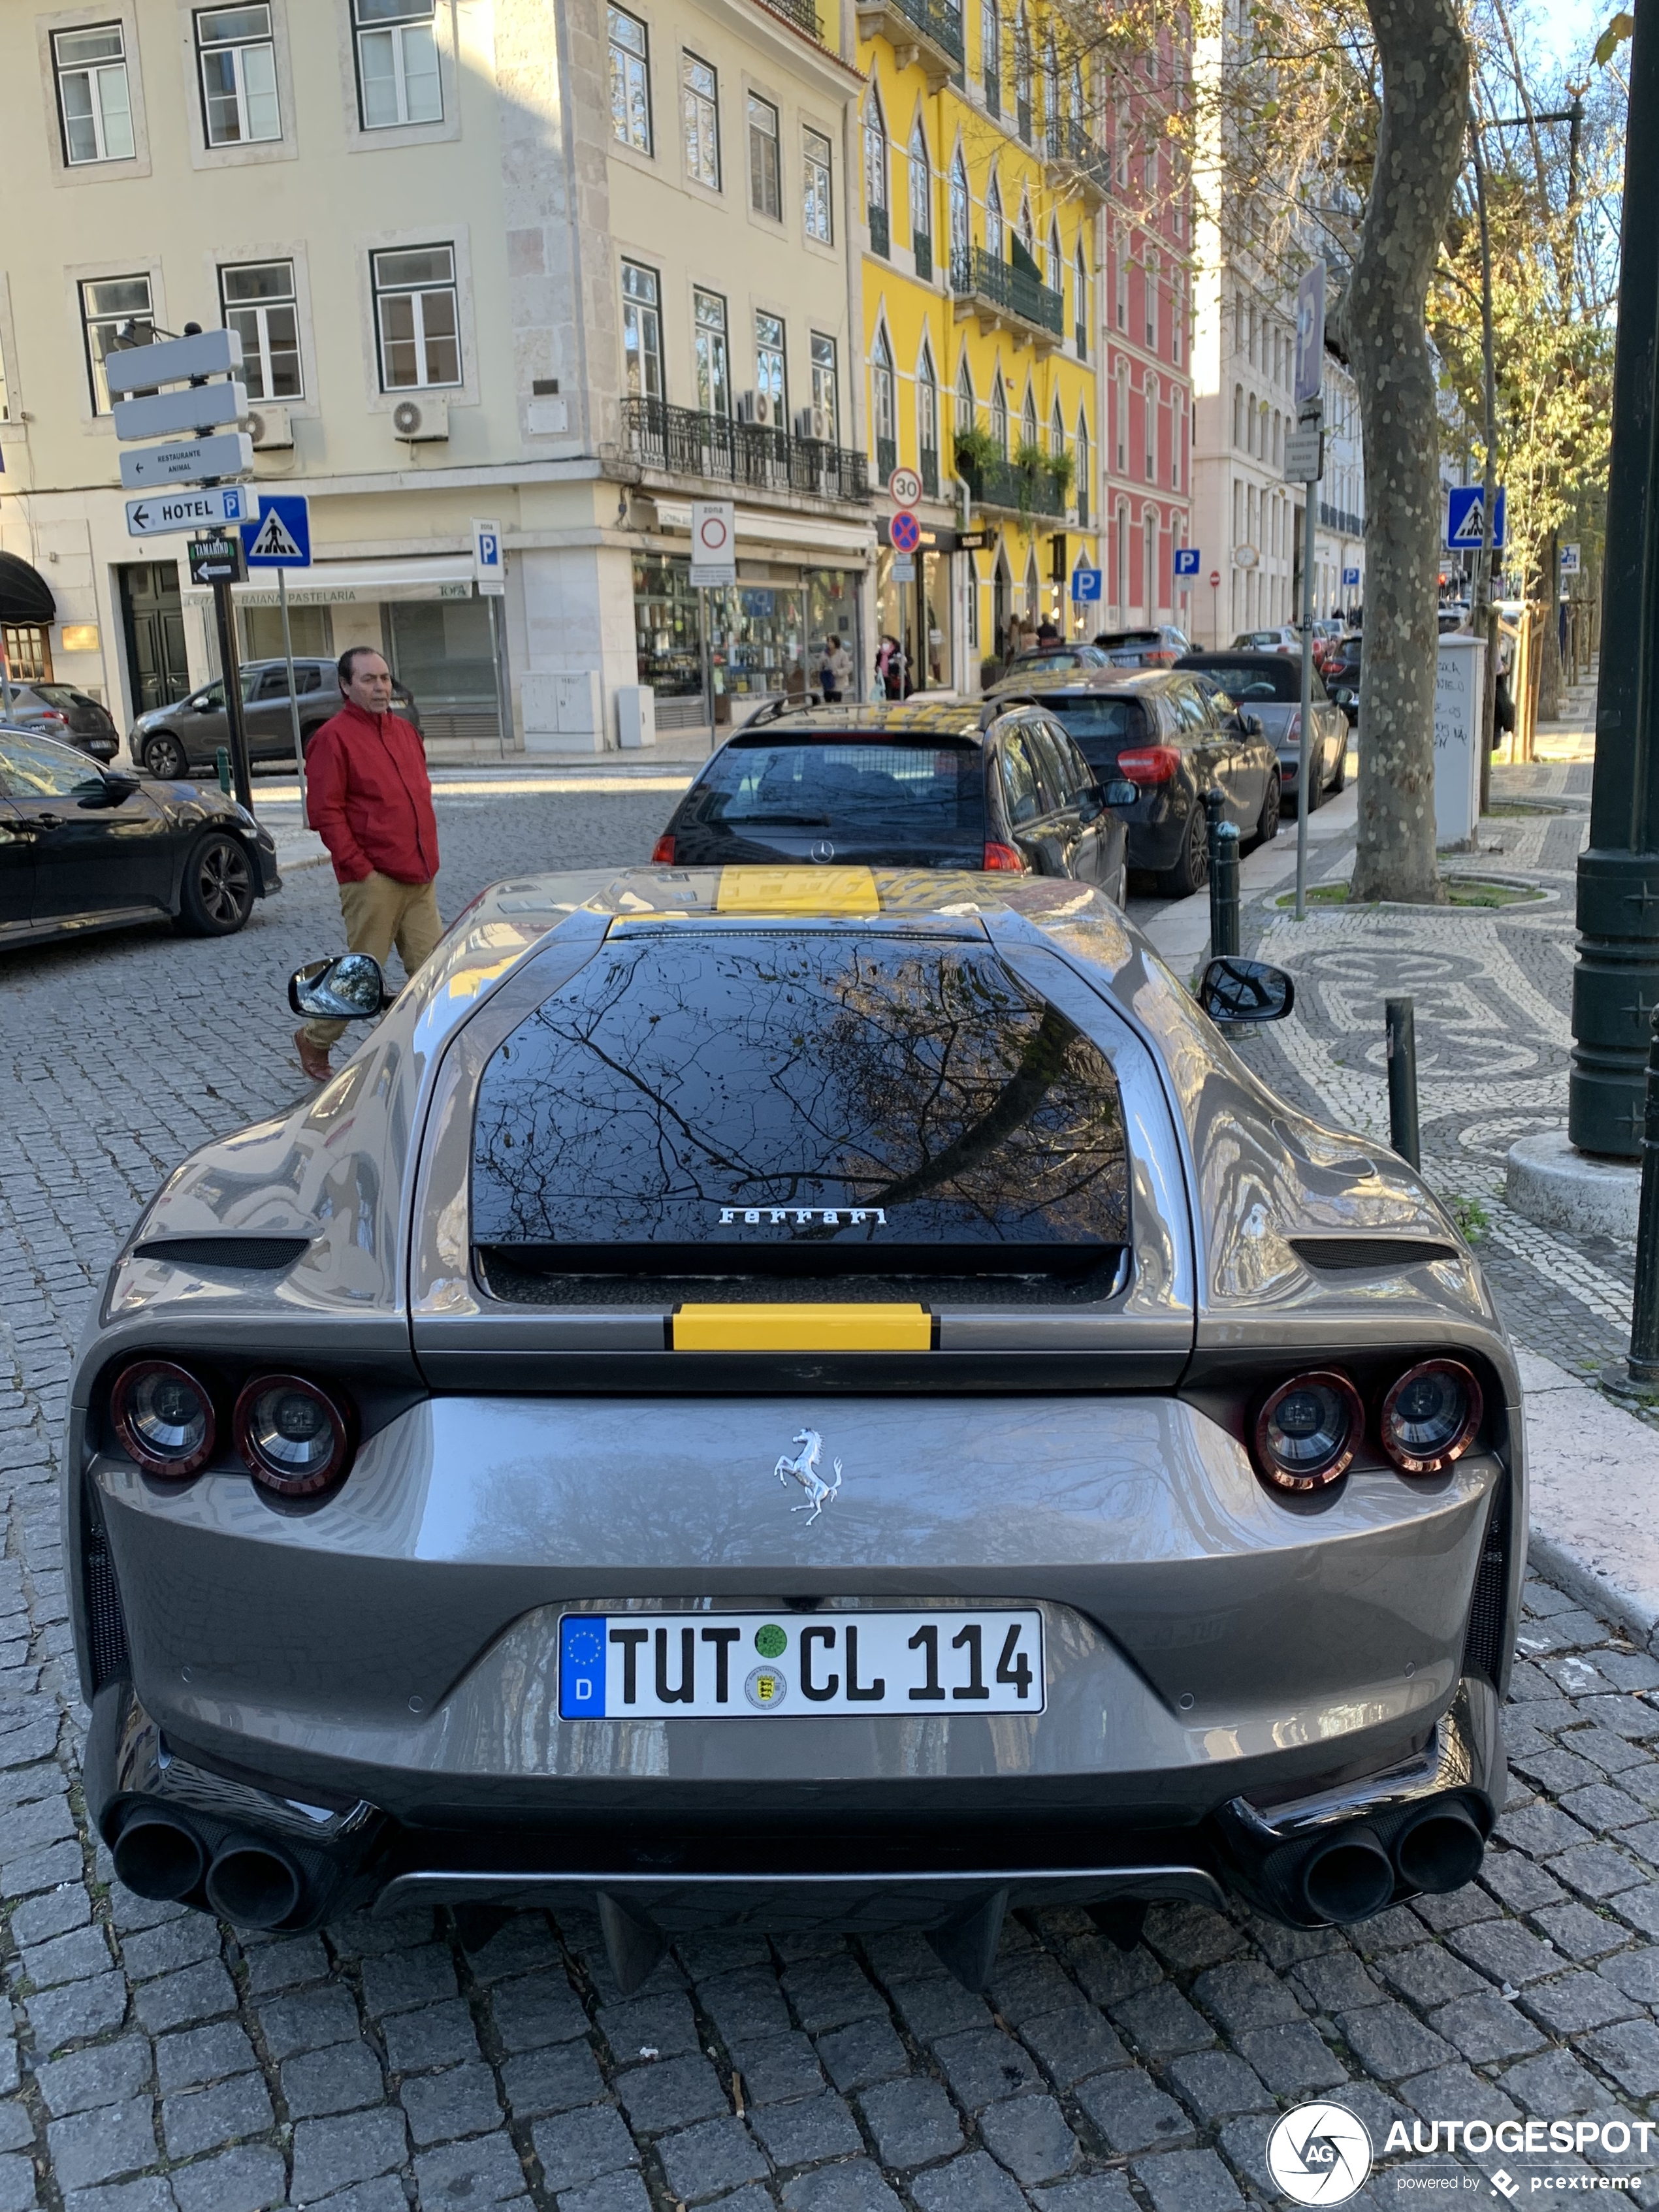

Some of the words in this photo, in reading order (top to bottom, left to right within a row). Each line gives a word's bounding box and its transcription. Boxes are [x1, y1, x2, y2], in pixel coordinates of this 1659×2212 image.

[157, 449, 201, 462] RESTAURANTE
[168, 463, 191, 473] ANIMAL
[895, 477, 917, 497] 30
[163, 500, 214, 521] HOTEL
[226, 498, 236, 517] P
[483, 537, 494, 564] P
[1180, 553, 1195, 573] P
[1078, 573, 1095, 599] P
[1346, 569, 1357, 583] P
[288, 590, 356, 603] PASTELARIA
[718, 1208, 887, 1225] Ferrari
[609, 1627, 741, 1704] TUT
[800, 1626, 885, 1701] CL
[908, 1624, 1033, 1701] 114
[575, 1678, 592, 1700] D
